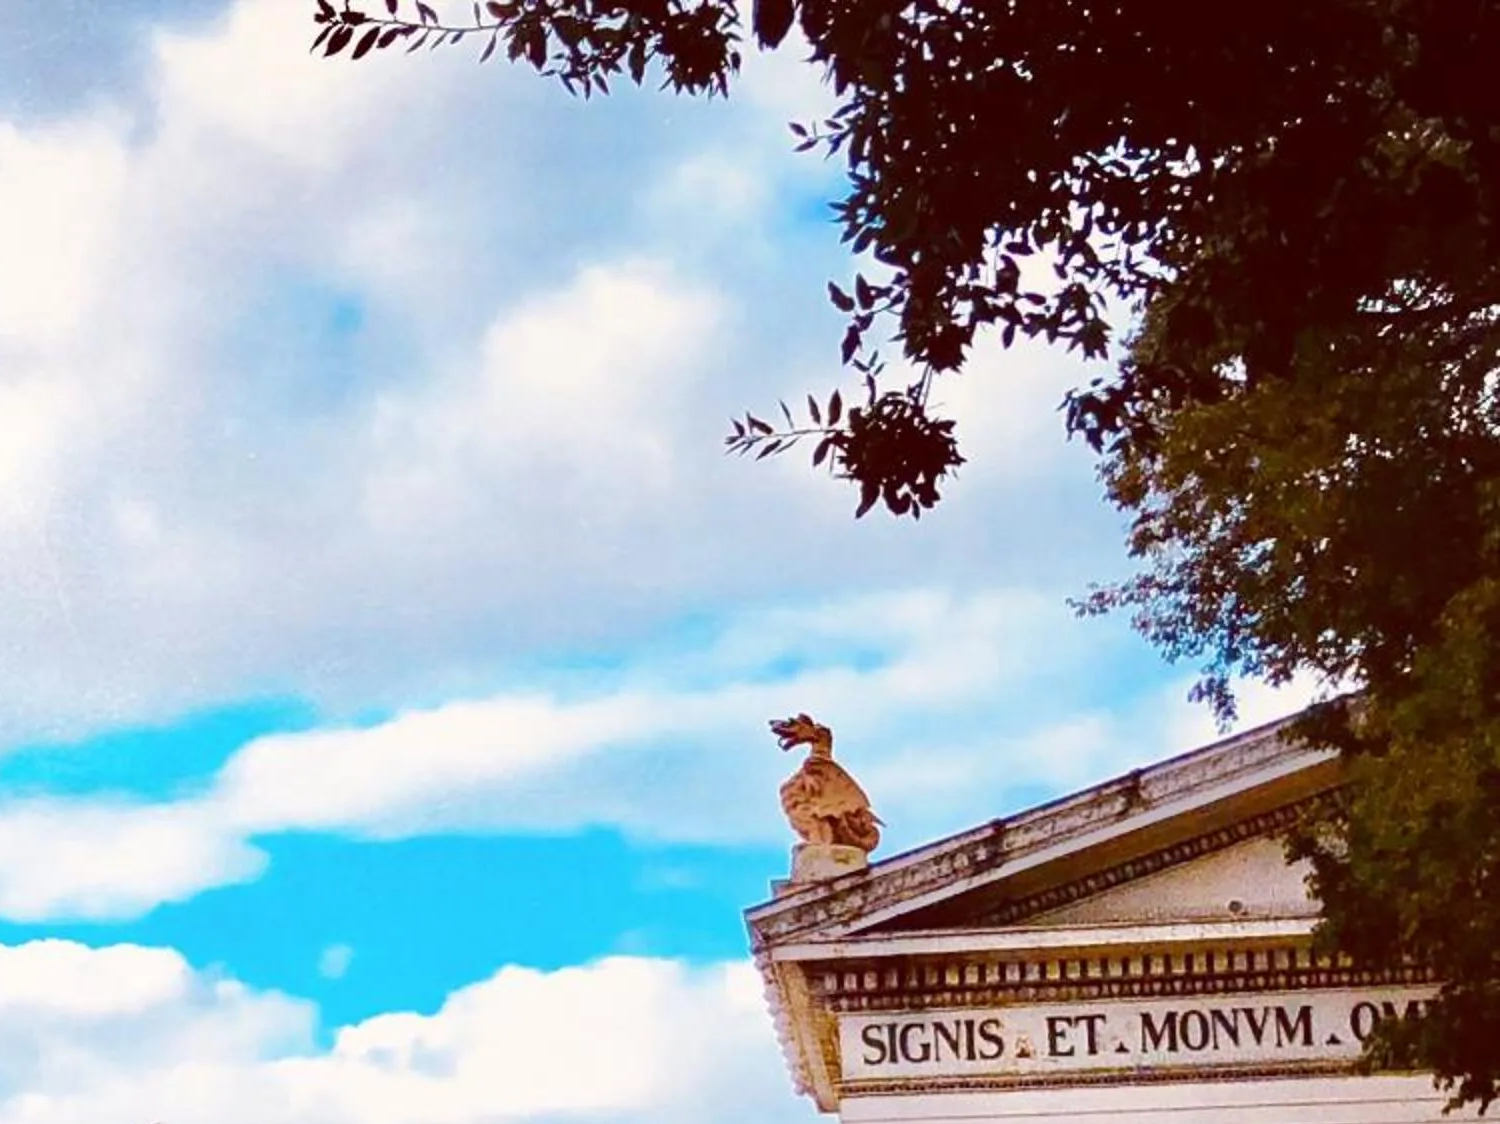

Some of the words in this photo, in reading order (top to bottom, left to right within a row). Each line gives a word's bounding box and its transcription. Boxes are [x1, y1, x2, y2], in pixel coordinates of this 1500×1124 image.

[861, 1018, 1004, 1066] SIGNIS
[1047, 1013, 1107, 1057] ET
[1140, 1007, 1313, 1053] MONVM
